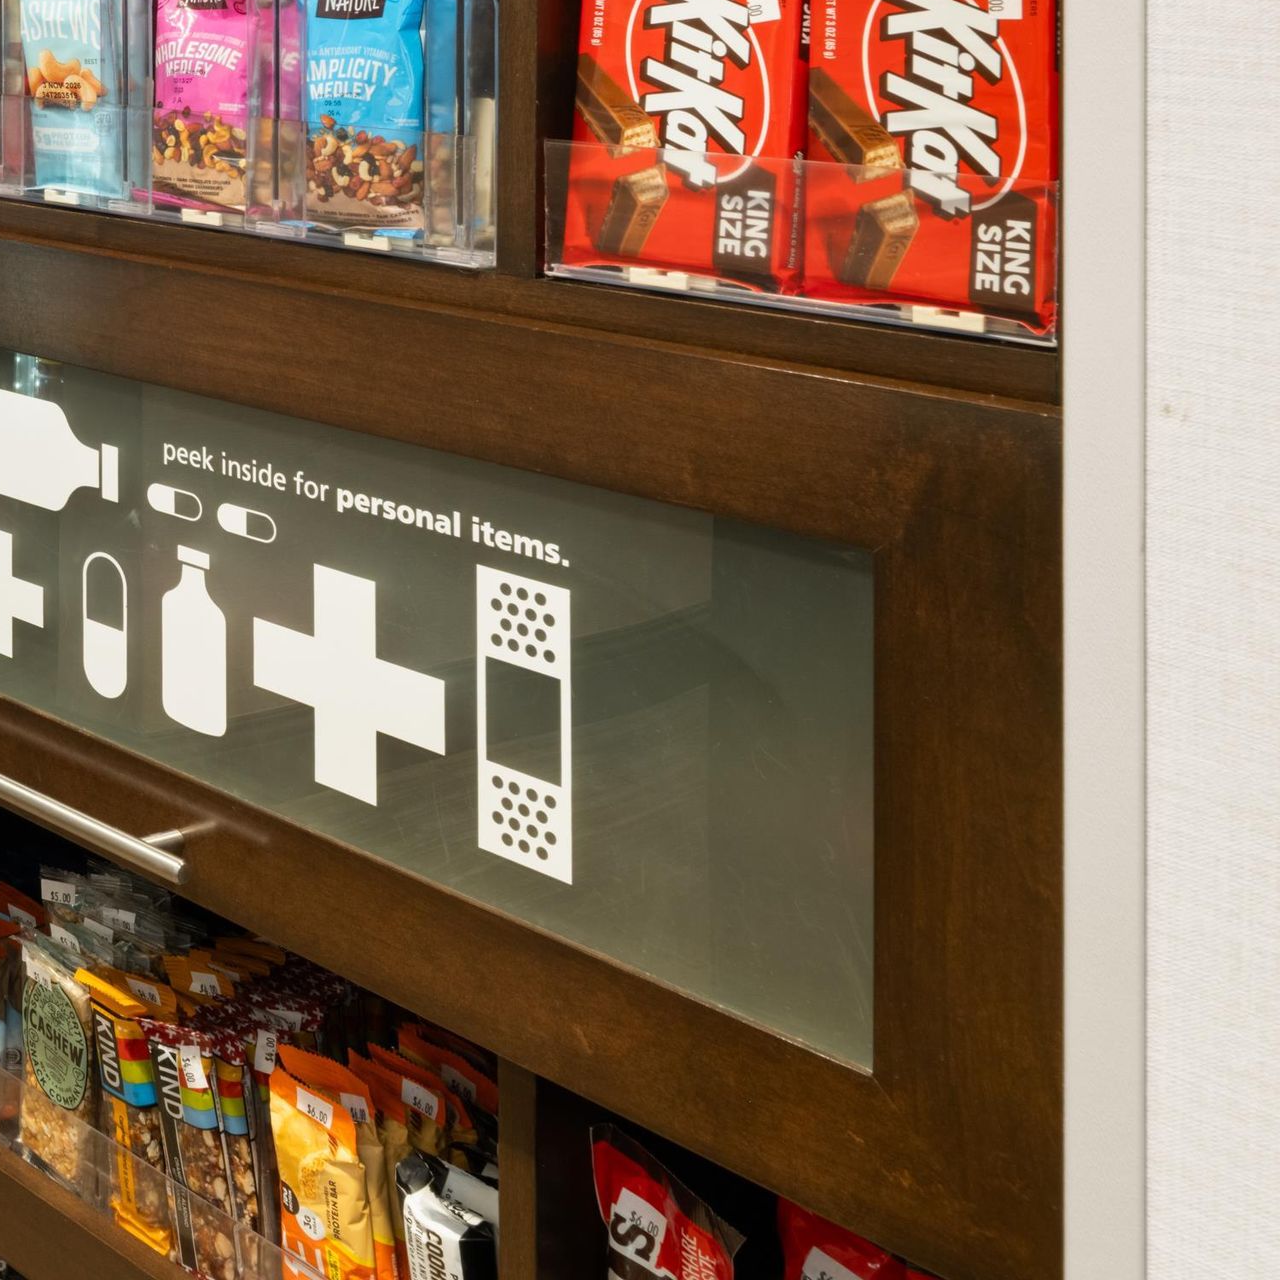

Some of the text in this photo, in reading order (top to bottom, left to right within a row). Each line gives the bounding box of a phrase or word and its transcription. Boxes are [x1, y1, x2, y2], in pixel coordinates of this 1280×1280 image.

[155, 42, 242, 71] WHOLESOME
[165, 61, 214, 79] MEDLEY
[306, 57, 398, 87] IMPLICITY
[308, 80, 376, 102] MEDLEY
[718, 194, 743, 256] SIZE
[742, 189, 771, 259] KING
[975, 223, 1002, 294] SIZE
[1002, 219, 1033, 297] KING
[163, 441, 571, 568] peek inside for personal items.
[50, 891, 72, 904] $5.00
[28, 1007, 85, 1069] CASHEW
[95, 1014, 121, 1089] KIND
[29, 1038, 85, 1109] SNACK COMPANY
[157, 1043, 184, 1120] KIND
[306, 1102, 329, 1124] $6.00
[412, 1096, 434, 1116] $6.00
[332, 1204, 341, 1240] PROTEIN
